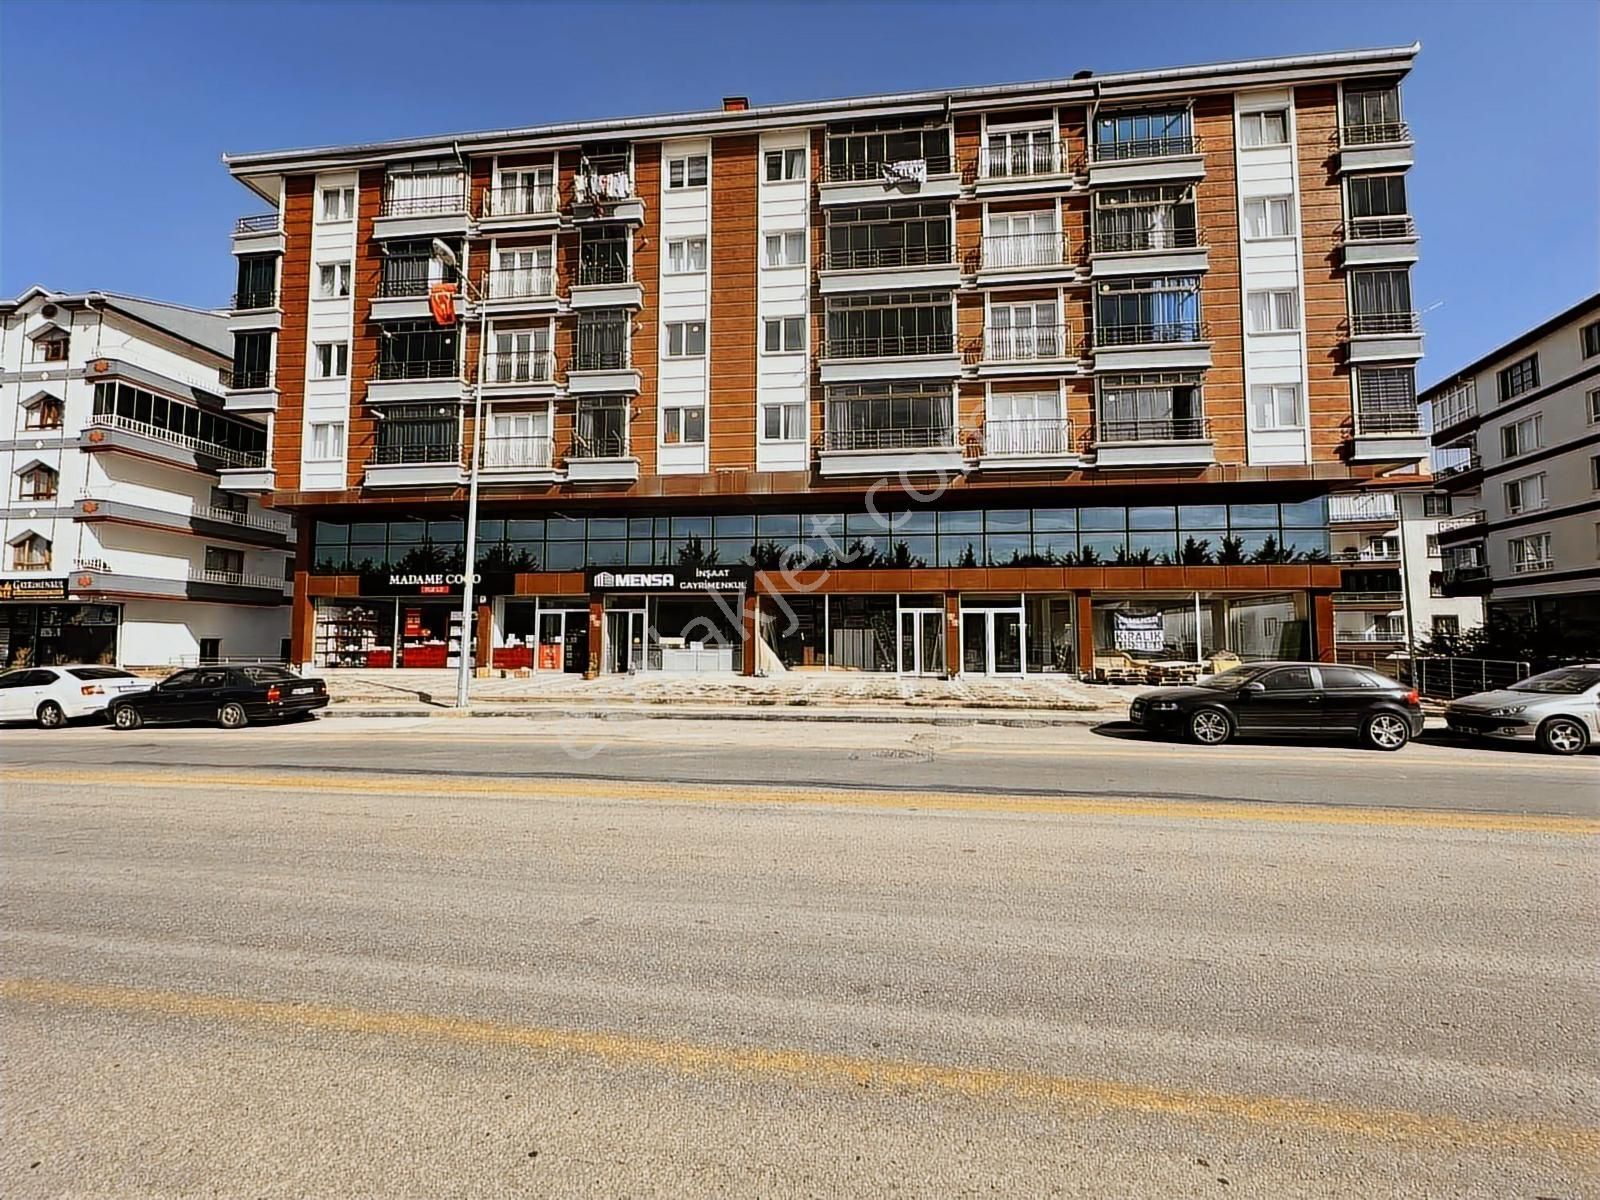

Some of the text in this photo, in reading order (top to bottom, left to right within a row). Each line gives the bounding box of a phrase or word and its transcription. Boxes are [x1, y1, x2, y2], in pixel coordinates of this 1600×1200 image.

[389, 573, 481, 585] MADAME COO
[615, 573, 674, 587] MENSA
